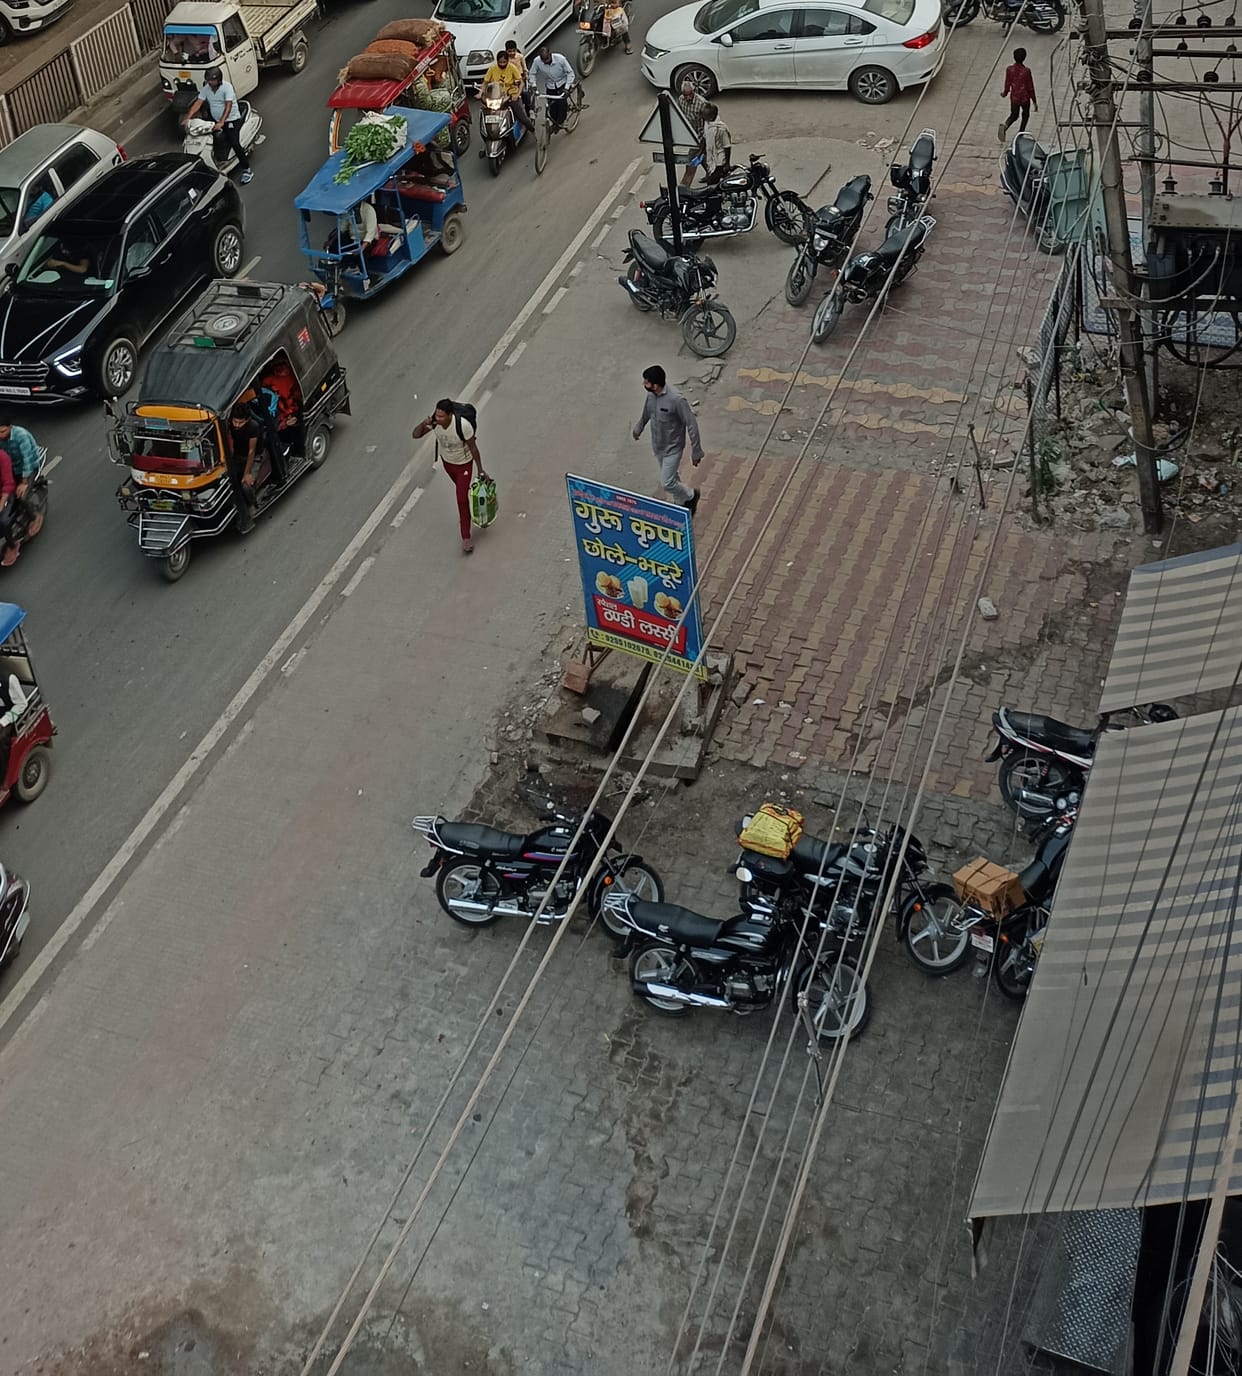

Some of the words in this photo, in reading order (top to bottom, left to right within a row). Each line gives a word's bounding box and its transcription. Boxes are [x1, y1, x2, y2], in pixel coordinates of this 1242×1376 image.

[628, 515, 684, 551] कृपा
[602, 607, 636, 629] ठण्डी
[638, 619, 679, 644] लस्सी
